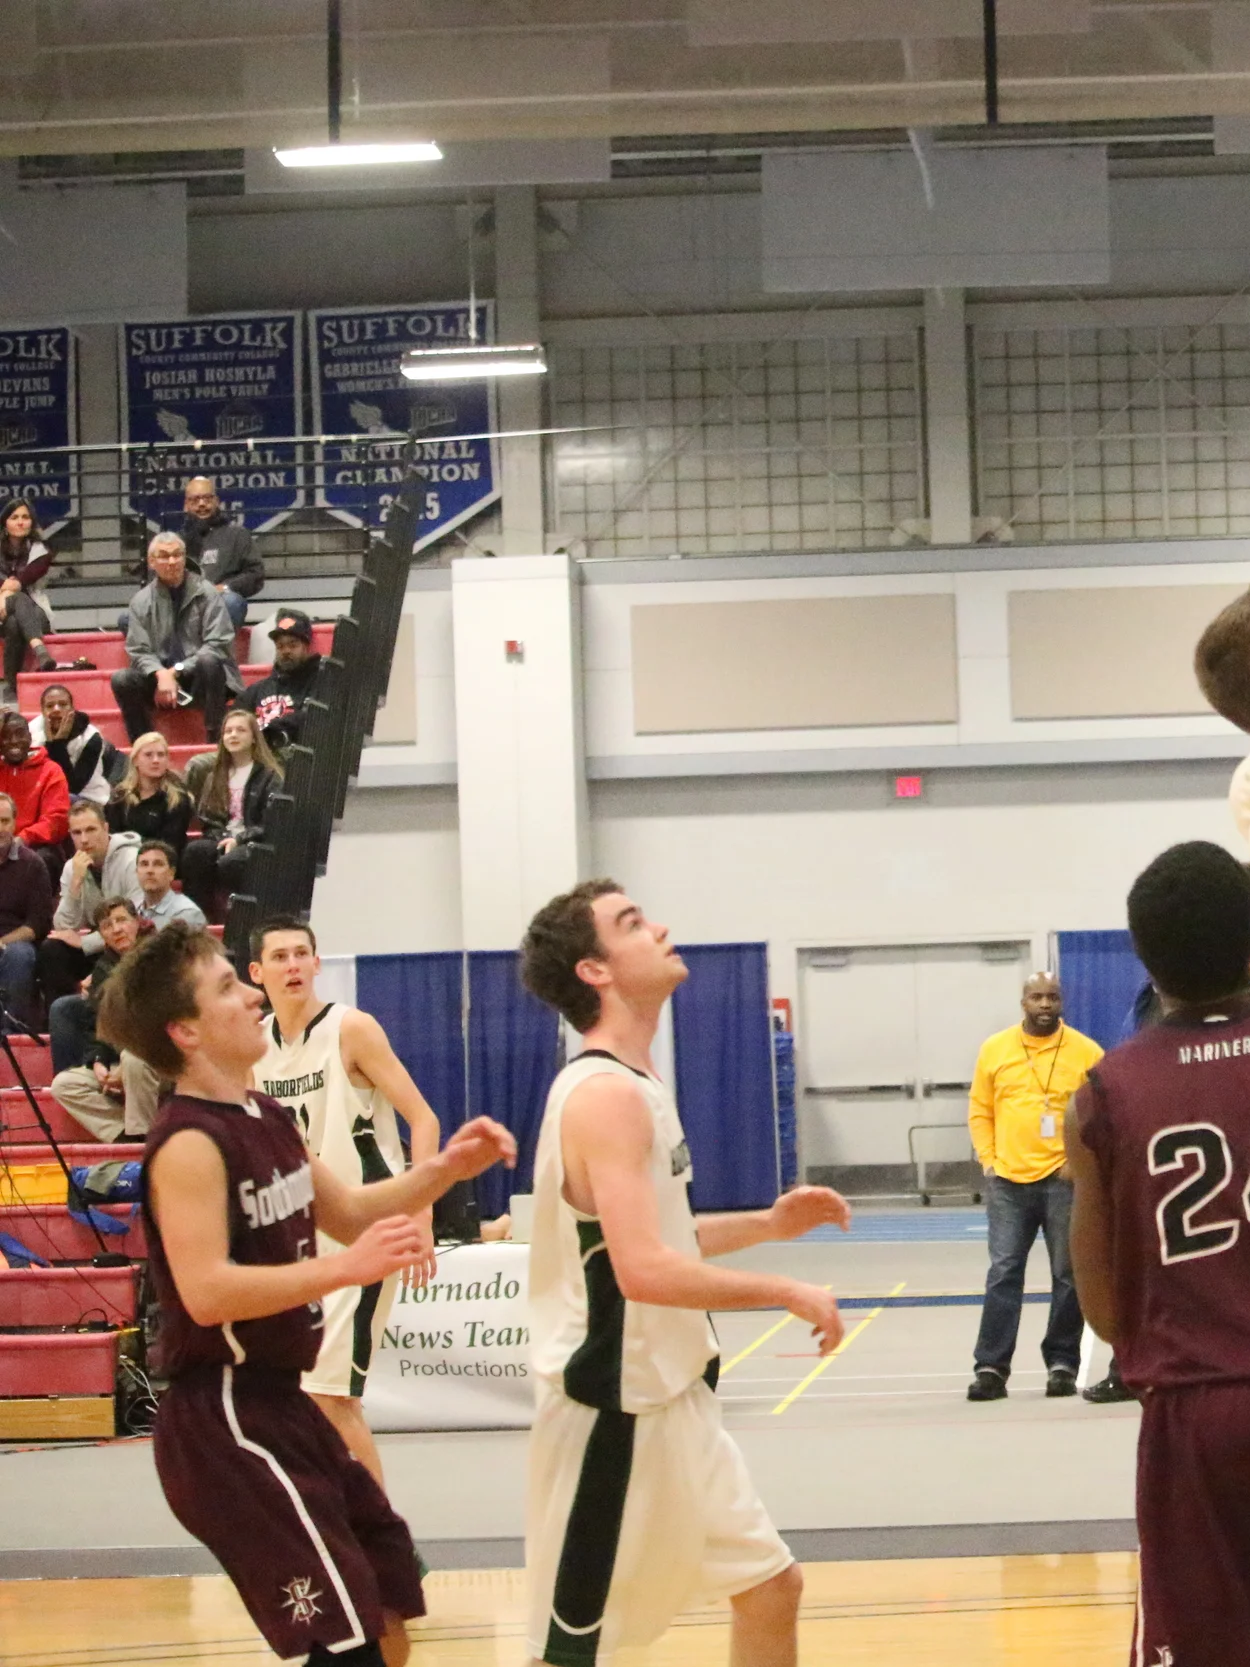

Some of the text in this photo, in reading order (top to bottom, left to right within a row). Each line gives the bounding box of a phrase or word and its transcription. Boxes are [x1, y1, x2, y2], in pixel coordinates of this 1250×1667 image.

[131, 322, 288, 356] SUFFOLK
[322, 313, 481, 349] SUFFOLK
[139, 349, 280, 365] COUNTY COMMUNITY COLLEGE
[144, 368, 198, 389] JOSIAH
[152, 383, 270, 401] MEN'S POLE VAULT
[397, 1271, 520, 1305] Tornado
[379, 1325, 454, 1350] News
[400, 1359, 528, 1378] Productions
